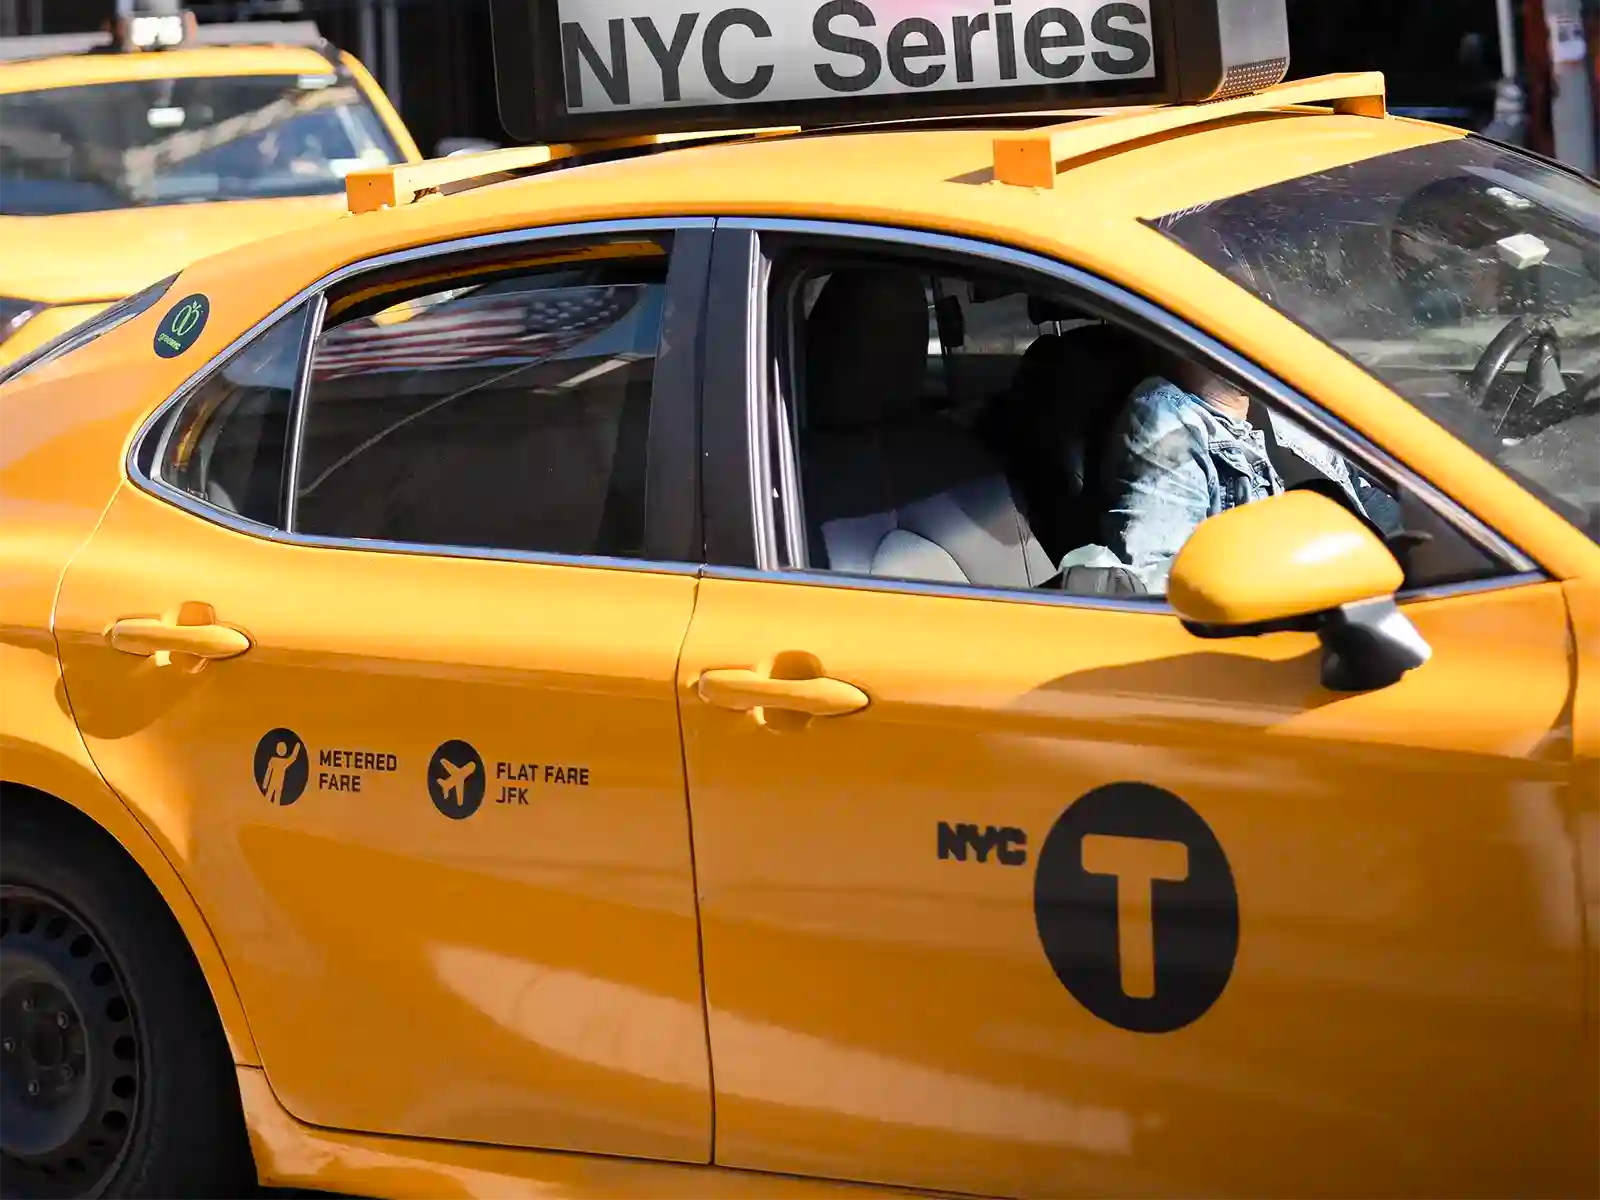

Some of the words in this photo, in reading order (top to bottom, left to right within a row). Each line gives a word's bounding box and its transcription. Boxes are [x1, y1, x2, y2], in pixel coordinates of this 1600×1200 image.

[562, 8, 775, 107] NYC
[320, 750, 397, 771] METERED
[320, 773, 361, 792] FARE
[496, 762, 539, 781] FLAT
[544, 766, 589, 785] FARE
[496, 787, 529, 805] JFK
[937, 822, 1027, 866] NYC
[1082, 834, 1189, 998] T
